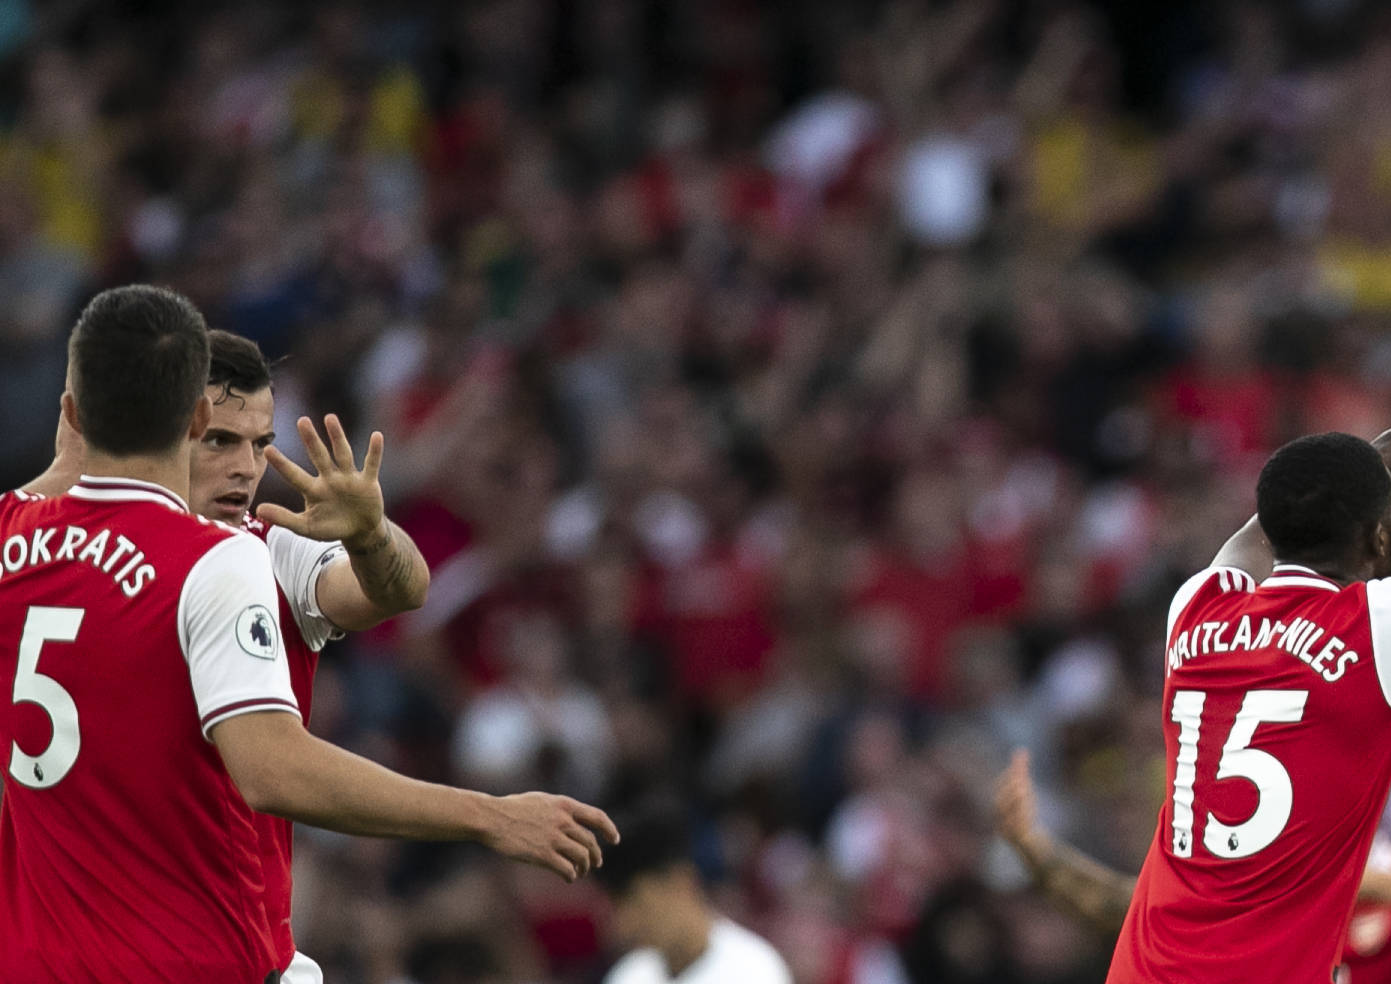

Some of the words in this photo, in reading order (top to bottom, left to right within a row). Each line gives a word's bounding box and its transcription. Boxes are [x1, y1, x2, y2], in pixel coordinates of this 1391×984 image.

[0, 525, 156, 598] OKRATIS
[8, 605, 86, 790] 5
[1171, 689, 1310, 859] 15
